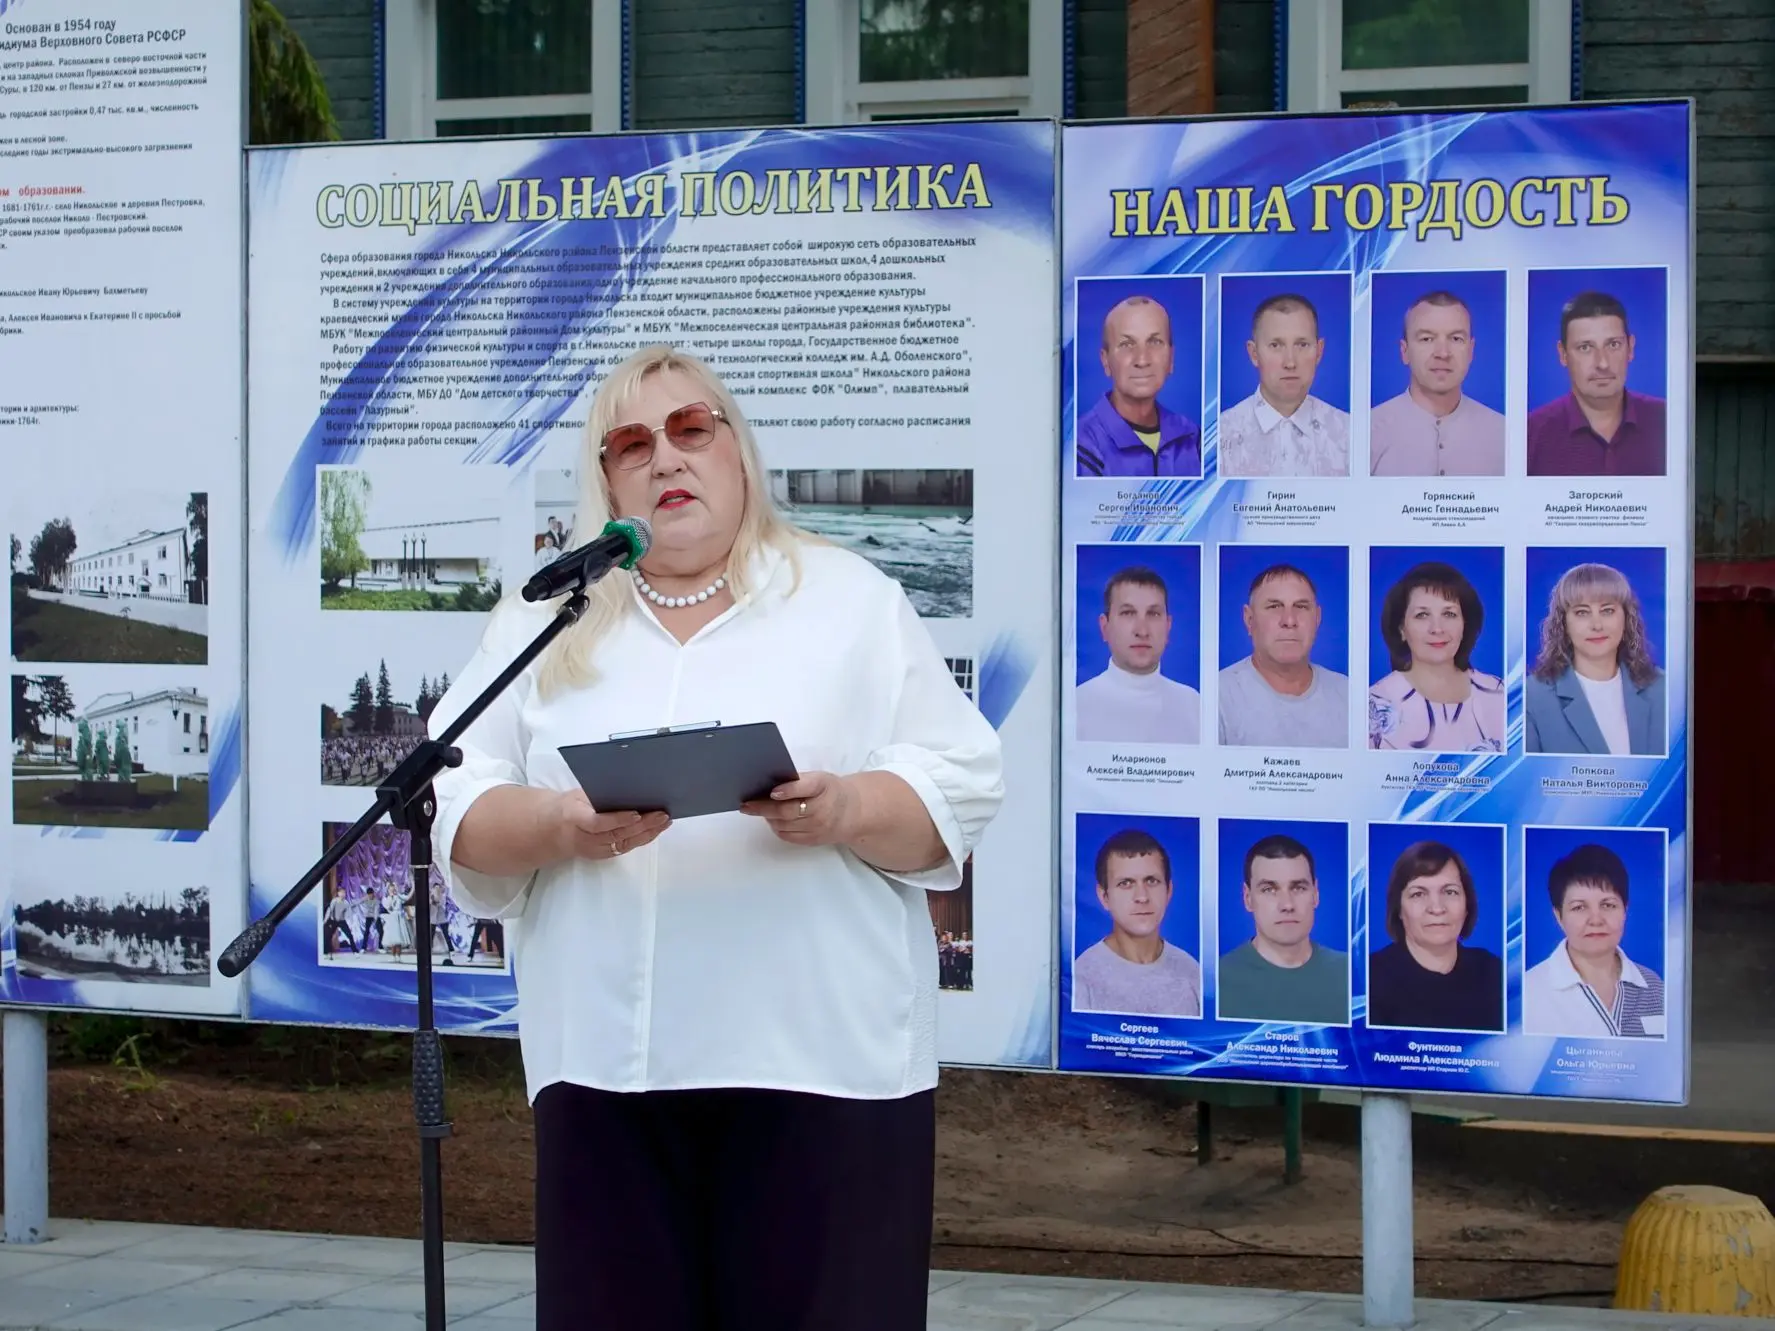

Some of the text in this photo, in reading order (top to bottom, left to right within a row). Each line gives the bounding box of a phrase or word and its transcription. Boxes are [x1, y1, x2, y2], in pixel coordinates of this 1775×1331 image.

[5, 19, 117, 34] Основан 1954 году
[40, 30, 187, 49] Верховного Совета РСФСР
[58, 50, 207, 65] Расположен части
[86, 64, 202, 79] Приволжской возвышенности
[49, 105, 88, 118] застройки
[150, 102, 199, 112] численность
[144, 141, 193, 153] загрязнения
[18, 182, 86, 198] образовании.
[73, 198, 118, 209] Никольское
[315, 162, 992, 236] СОЦИАЛЬНАЯ ПОЛИТИКА
[1109, 175, 1631, 243] НАША ГОРДОСТЬ
[63, 223, 117, 237] преобразовал
[118, 222, 151, 235] рабочий
[152, 223, 183, 232] поселок
[320, 236, 977, 266] Сфера образования города Никольска области представляет собой широкую сеть образовательных
[705, 255, 945, 272] средних образовательных дошкольных
[319, 269, 916, 296] учреждения начального профессионального образования.
[62, 285, 100, 298] Юрьевичу
[341, 288, 926, 310] систему входит муниципальное бюджетное учреждение культуры
[90, 310, 130, 322] Екатерине
[144, 309, 182, 321] просьбой
[319, 303, 951, 326] краеведческий Никольска Никольского Пензенской области, расположены районные учреждения культуры
[320, 317, 976, 339] МБУК центральный МБУК "Межпоселенческая центральная районная библиотека".
[332, 342, 364, 356] Работу
[425, 341, 481, 355] физической
[483, 342, 525, 354] культуры
[578, 338, 636, 350] г.Никольске
[692, 339, 729, 351] четыре
[731, 339, 766, 348] школы
[768, 338, 807, 350] города,
[808, 335, 898, 349] Государственное
[899, 334, 959, 347] бюджетное
[407, 356, 488, 370] образовательное
[548, 355, 606, 366] Пензенской
[717, 352, 803, 364] технологический
[805, 354, 849, 365] колледж
[894, 350, 973, 364] Оболенского",
[393, 373, 444, 385] бюджетное
[446, 374, 502, 386] учреждение
[503, 373, 584, 384] дополнительного
[757, 370, 818, 382] спортивная
[820, 368, 859, 379] школа"
[862, 367, 930, 378] Никольского
[932, 367, 971, 380] района
[455, 383, 969, 400] "Дом детского комплекс ФОК плавательный
[366, 416, 971, 432] территории города расположено свою работу согласно расписания
[367, 434, 480, 447] графика работы секции.
[1267, 491, 1295, 501] Гирин
[1423, 491, 1475, 502] Горянский
[1568, 490, 1623, 501] Загорский
[1233, 503, 1336, 513] Евгений Анатольевич
[1401, 504, 1500, 515] Денис Геннадьевич
[1545, 503, 1648, 514] Андрей Николаевич
[1111, 754, 1167, 765] Илларионов
[1263, 756, 1301, 766] Кажаев
[1087, 765, 1195, 779] Алексей Владимирович
[1223, 768, 1343, 782] Дмитрий Александрович
[1412, 762, 1459, 773] Лопухова
[1571, 766, 1615, 776] Попкова
[1385, 773, 1490, 786] Анна Александровна
[1542, 778, 1648, 791] Наталья Викторовна
[1120, 1022, 1159, 1035] Сергеев
[1091, 1033, 1188, 1048] Вячеслав Сергеевич
[1265, 1031, 1299, 1043] Старов
[1226, 1041, 1339, 1056] Александр Николаевич
[1408, 1041, 1462, 1053] Фунтикова
[1374, 1052, 1420, 1064] Людмила
[1422, 1054, 1501, 1069] Александровна
